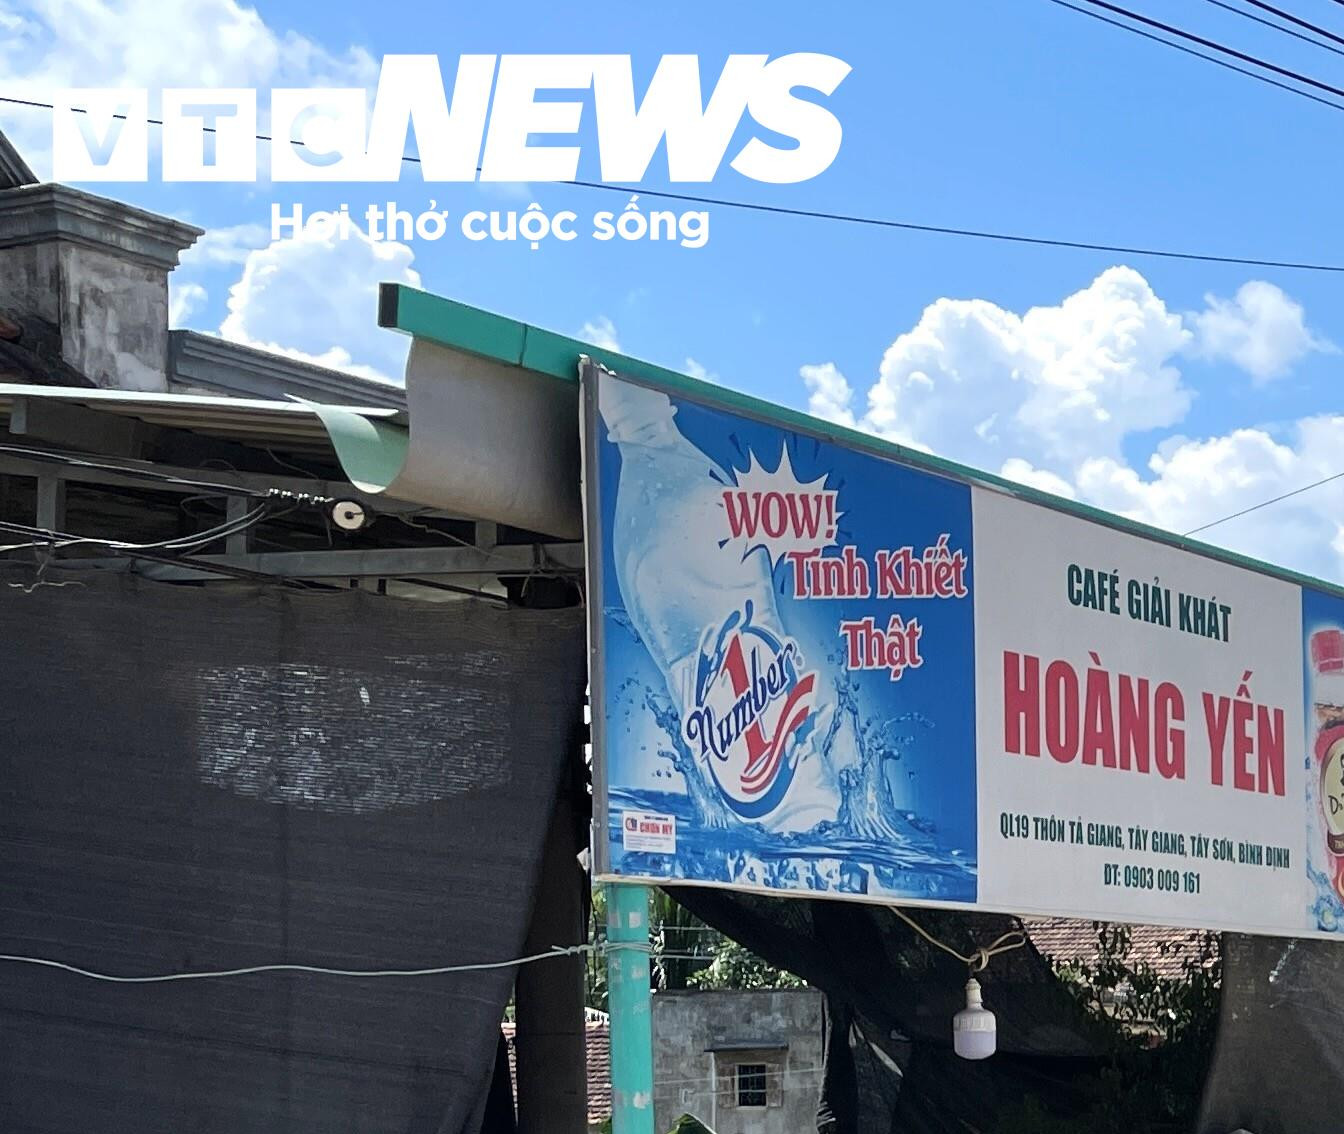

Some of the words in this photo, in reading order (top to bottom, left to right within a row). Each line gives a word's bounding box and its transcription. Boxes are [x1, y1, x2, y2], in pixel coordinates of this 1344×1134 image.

[723, 491, 834, 539] WOW!
[876, 535, 966, 597] Khiết
[1067, 563, 1121, 616] CAFÉ
[1127, 576, 1171, 628] GIẢI
[1179, 593, 1232, 643] KHÁT
[842, 617, 921, 679] Thật
[686, 643, 794, 761] Number
[1003, 650, 1186, 781] HOÀNG
[1201, 670, 1286, 797] YẾN
[1000, 812, 1029, 839] QL19
[1033, 815, 1065, 843] THÔN
[1087, 823, 1125, 850] GIANG,
[1128, 824, 1149, 852] TÂY
[1151, 831, 1188, 858] GIANG,
[1191, 833, 1210, 859] TÂY
[1239, 841, 1263, 866] BÌNH
[1124, 866, 1154, 890] 0903
[1157, 869, 1179, 892] 009
[1183, 871, 1201, 894] 161
